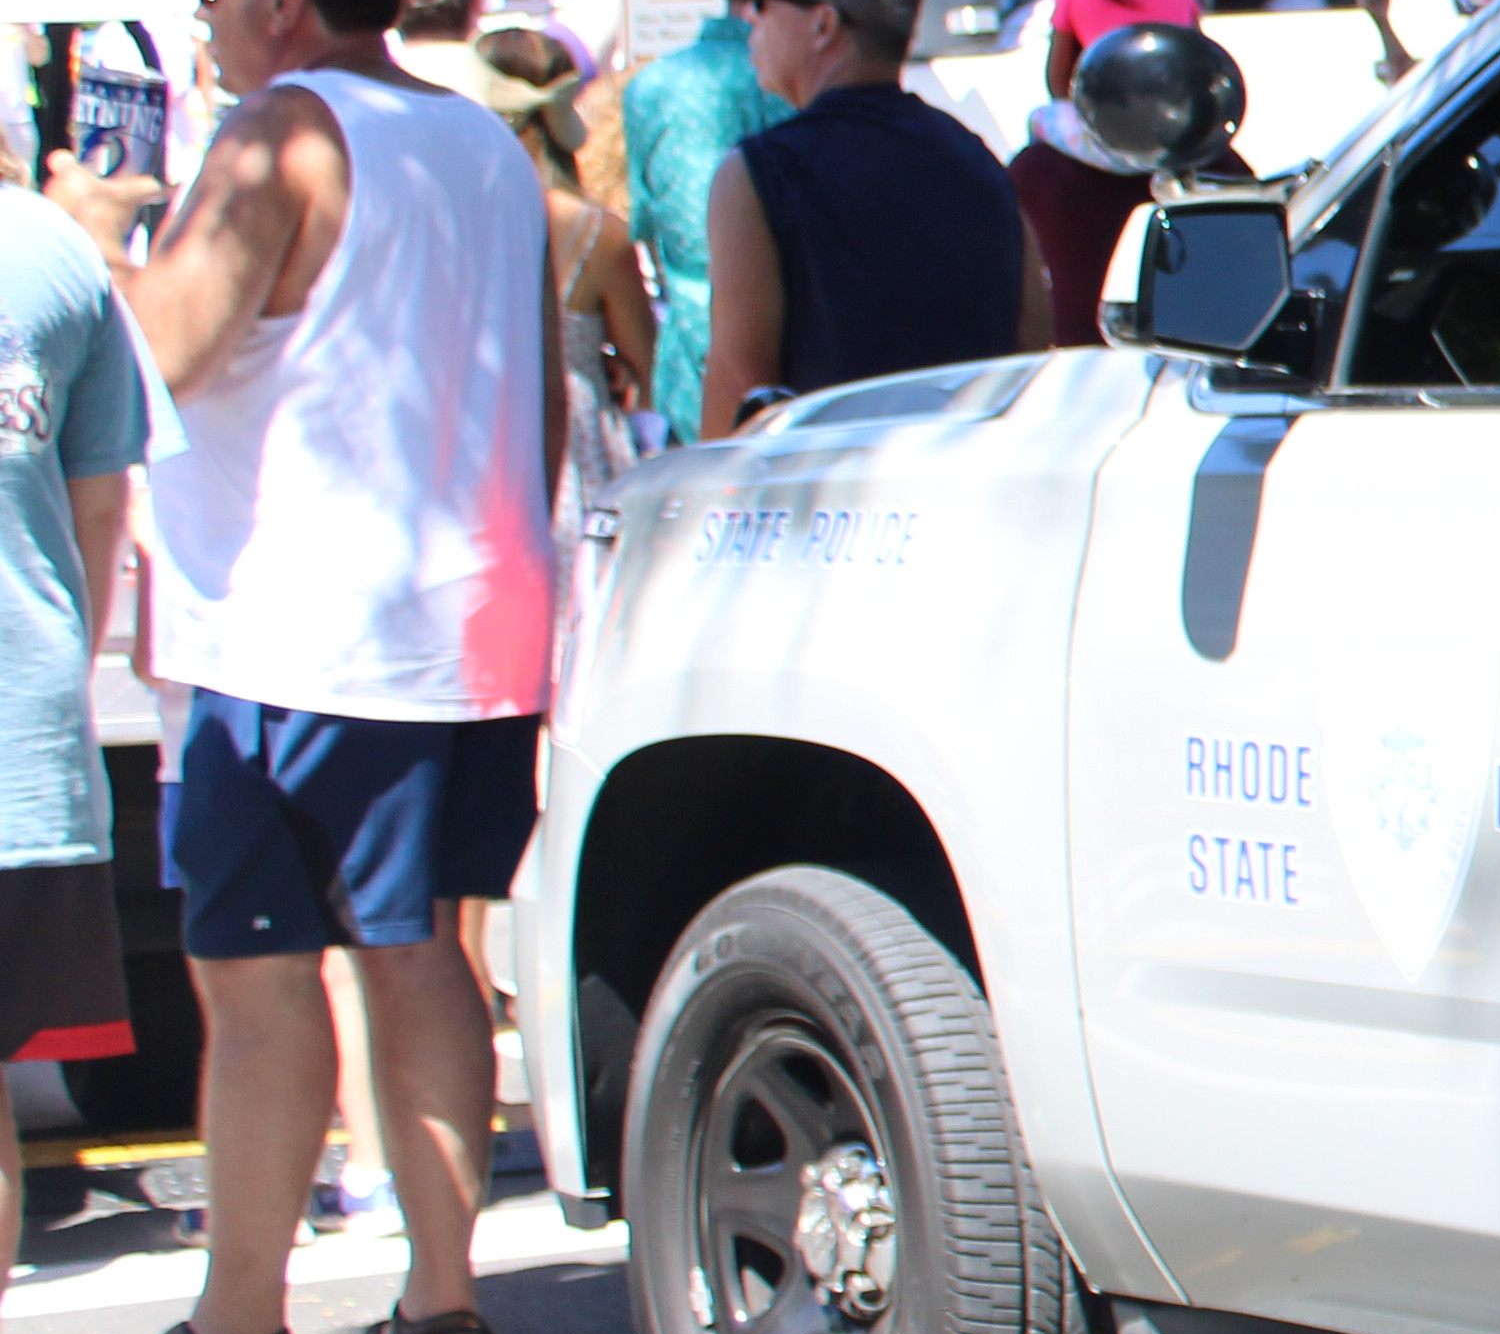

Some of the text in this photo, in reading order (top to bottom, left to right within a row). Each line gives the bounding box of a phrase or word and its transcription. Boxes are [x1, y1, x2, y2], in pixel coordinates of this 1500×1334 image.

[695, 508, 919, 566] STATE POLICE
[1185, 734, 1315, 809] RHODE
[1187, 832, 1300, 907] STATE
